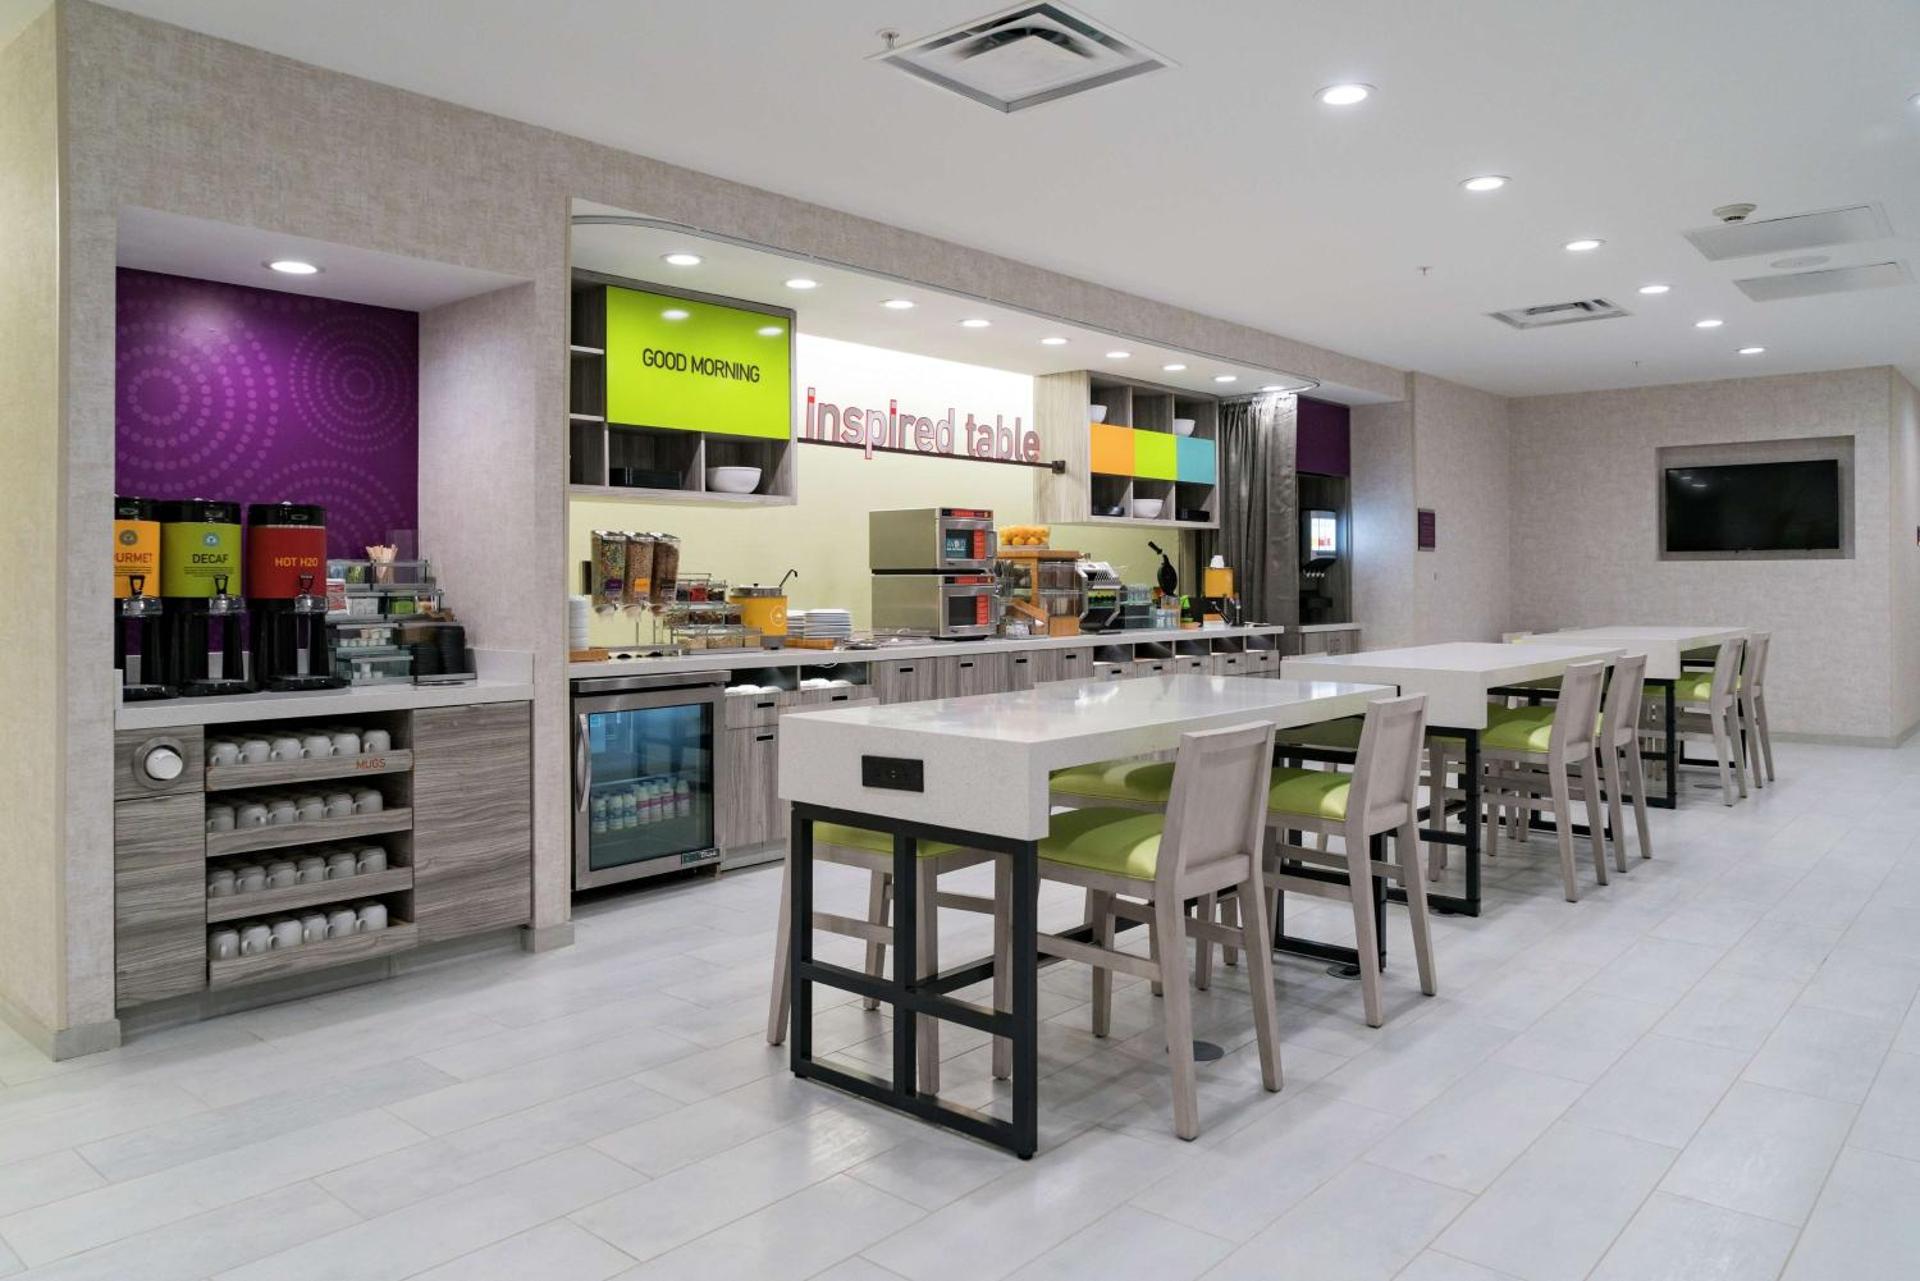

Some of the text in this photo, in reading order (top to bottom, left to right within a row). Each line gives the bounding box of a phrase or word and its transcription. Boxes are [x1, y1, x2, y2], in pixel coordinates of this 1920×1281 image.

[643, 348, 760, 383] GOOD MORNING
[806, 387, 1040, 462] inspired table
[115, 552, 152, 563] URMET
[192, 553, 229, 563] DECAF
[275, 557, 297, 567] HOT
[356, 758, 386, 769] MUGS
